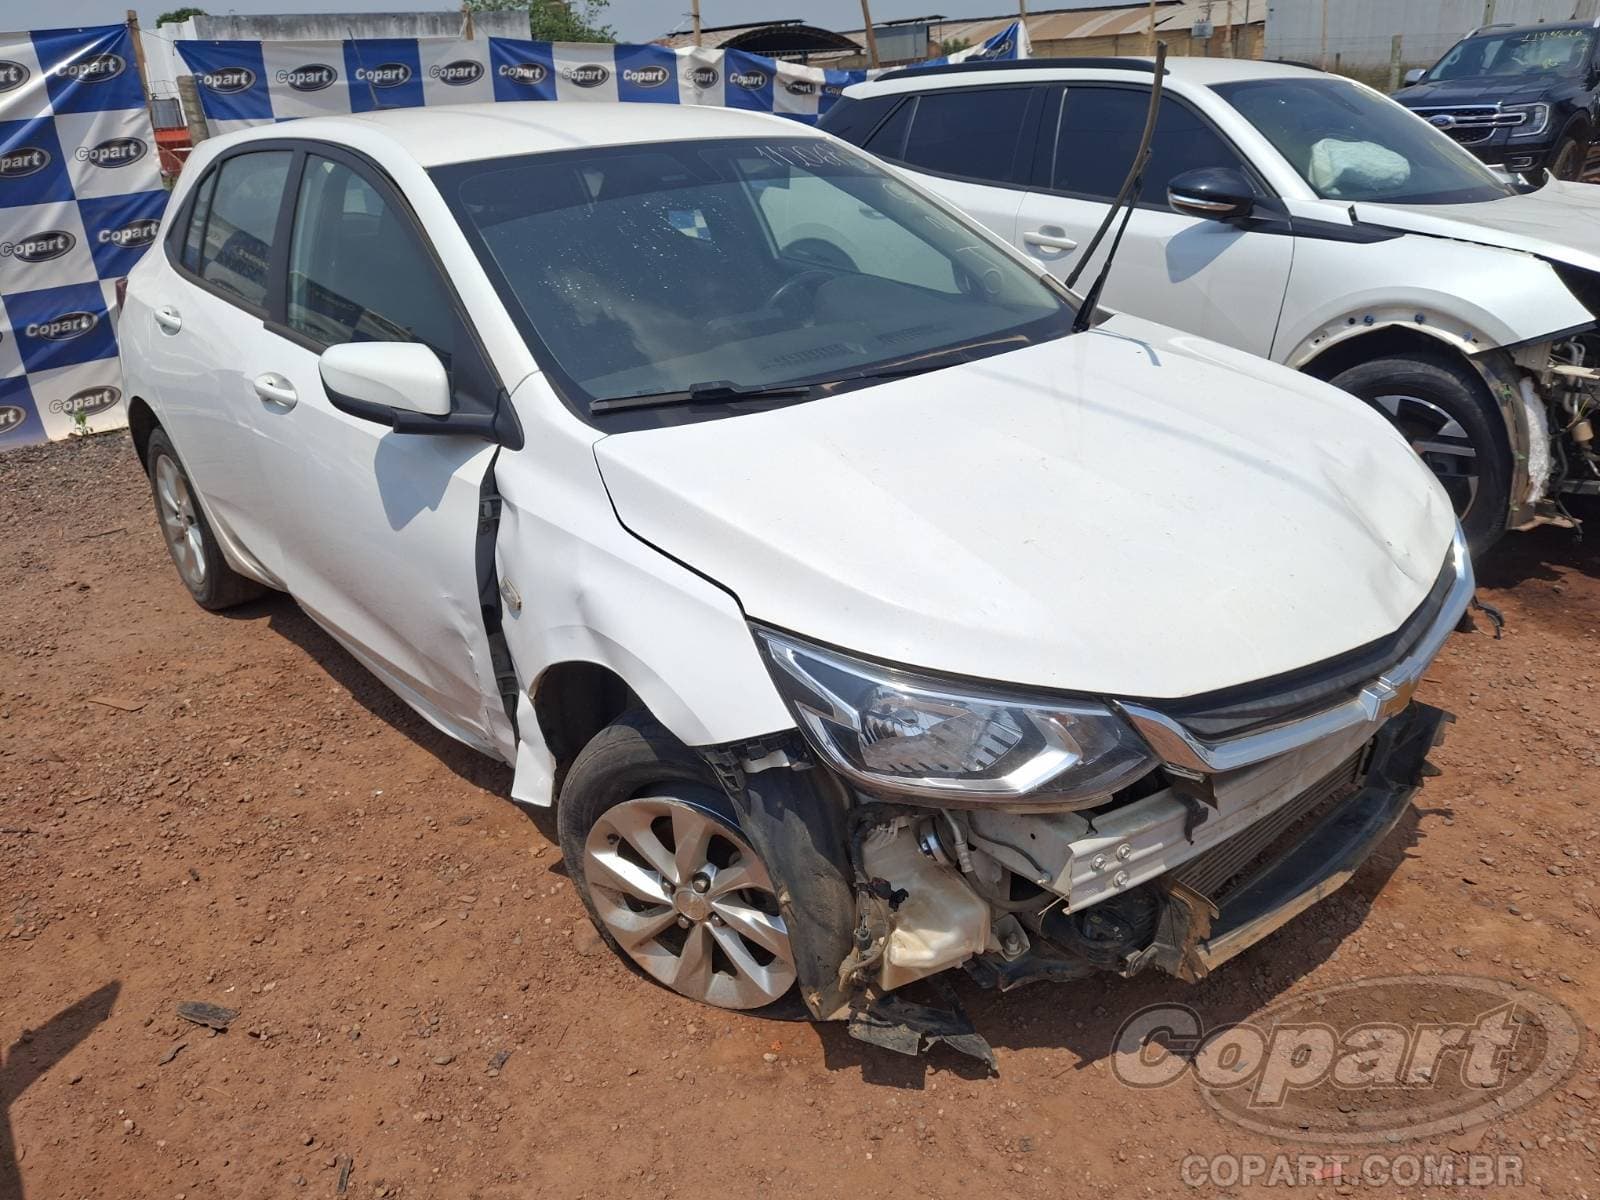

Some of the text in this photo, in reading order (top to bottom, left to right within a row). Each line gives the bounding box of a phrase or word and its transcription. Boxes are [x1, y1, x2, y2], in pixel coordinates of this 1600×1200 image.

[276, 69, 329, 85] Copart
[355, 67, 406, 83] Copart
[429, 65, 477, 81] Copart
[498, 64, 541, 81] Copart
[561, 67, 604, 82] Copart
[623, 69, 664, 83] Copart
[686, 69, 714, 83] Cpart
[729, 72, 763, 86] Copart
[75, 143, 137, 162] Copart
[99, 223, 158, 243] Copart
[0, 237, 65, 257] Copart
[26, 315, 88, 337] Copart
[49, 390, 112, 414] Copart
